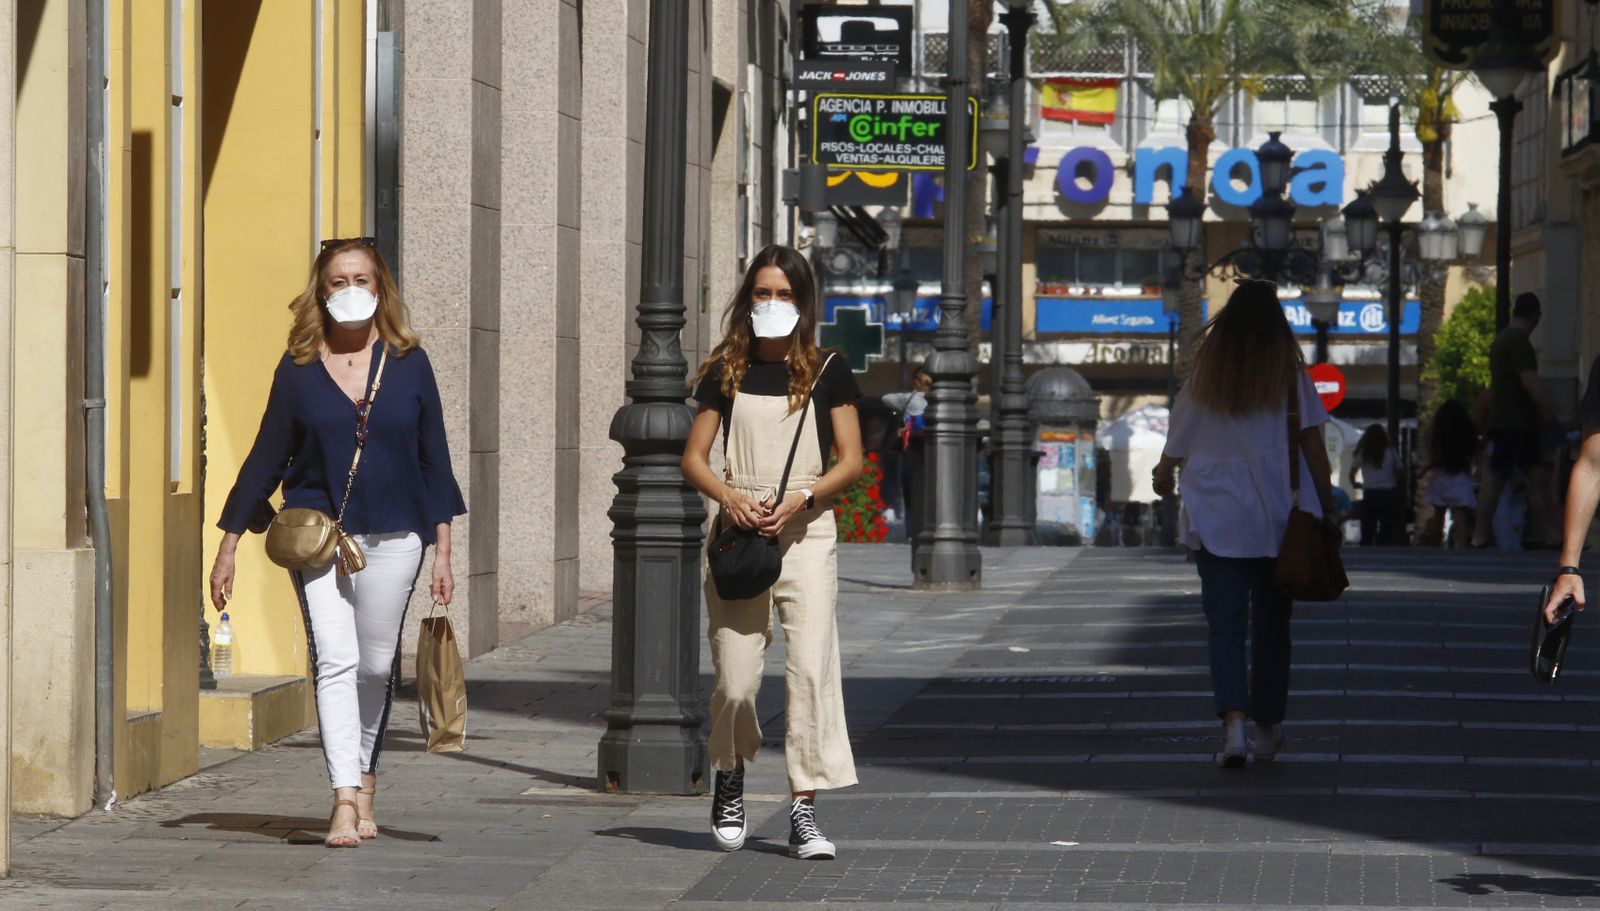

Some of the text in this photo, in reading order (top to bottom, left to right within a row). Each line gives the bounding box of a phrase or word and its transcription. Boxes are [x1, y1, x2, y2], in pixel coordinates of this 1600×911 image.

[799, 71, 886, 81] JACK JONES
[819, 98, 872, 113] AGENCIA
[876, 100, 888, 113] P.
[849, 114, 941, 142] Cinfer
[821, 142, 945, 155] PISOS-LOCALES-CHAL
[836, 153, 945, 165] VENTAS-ALQUILERE
